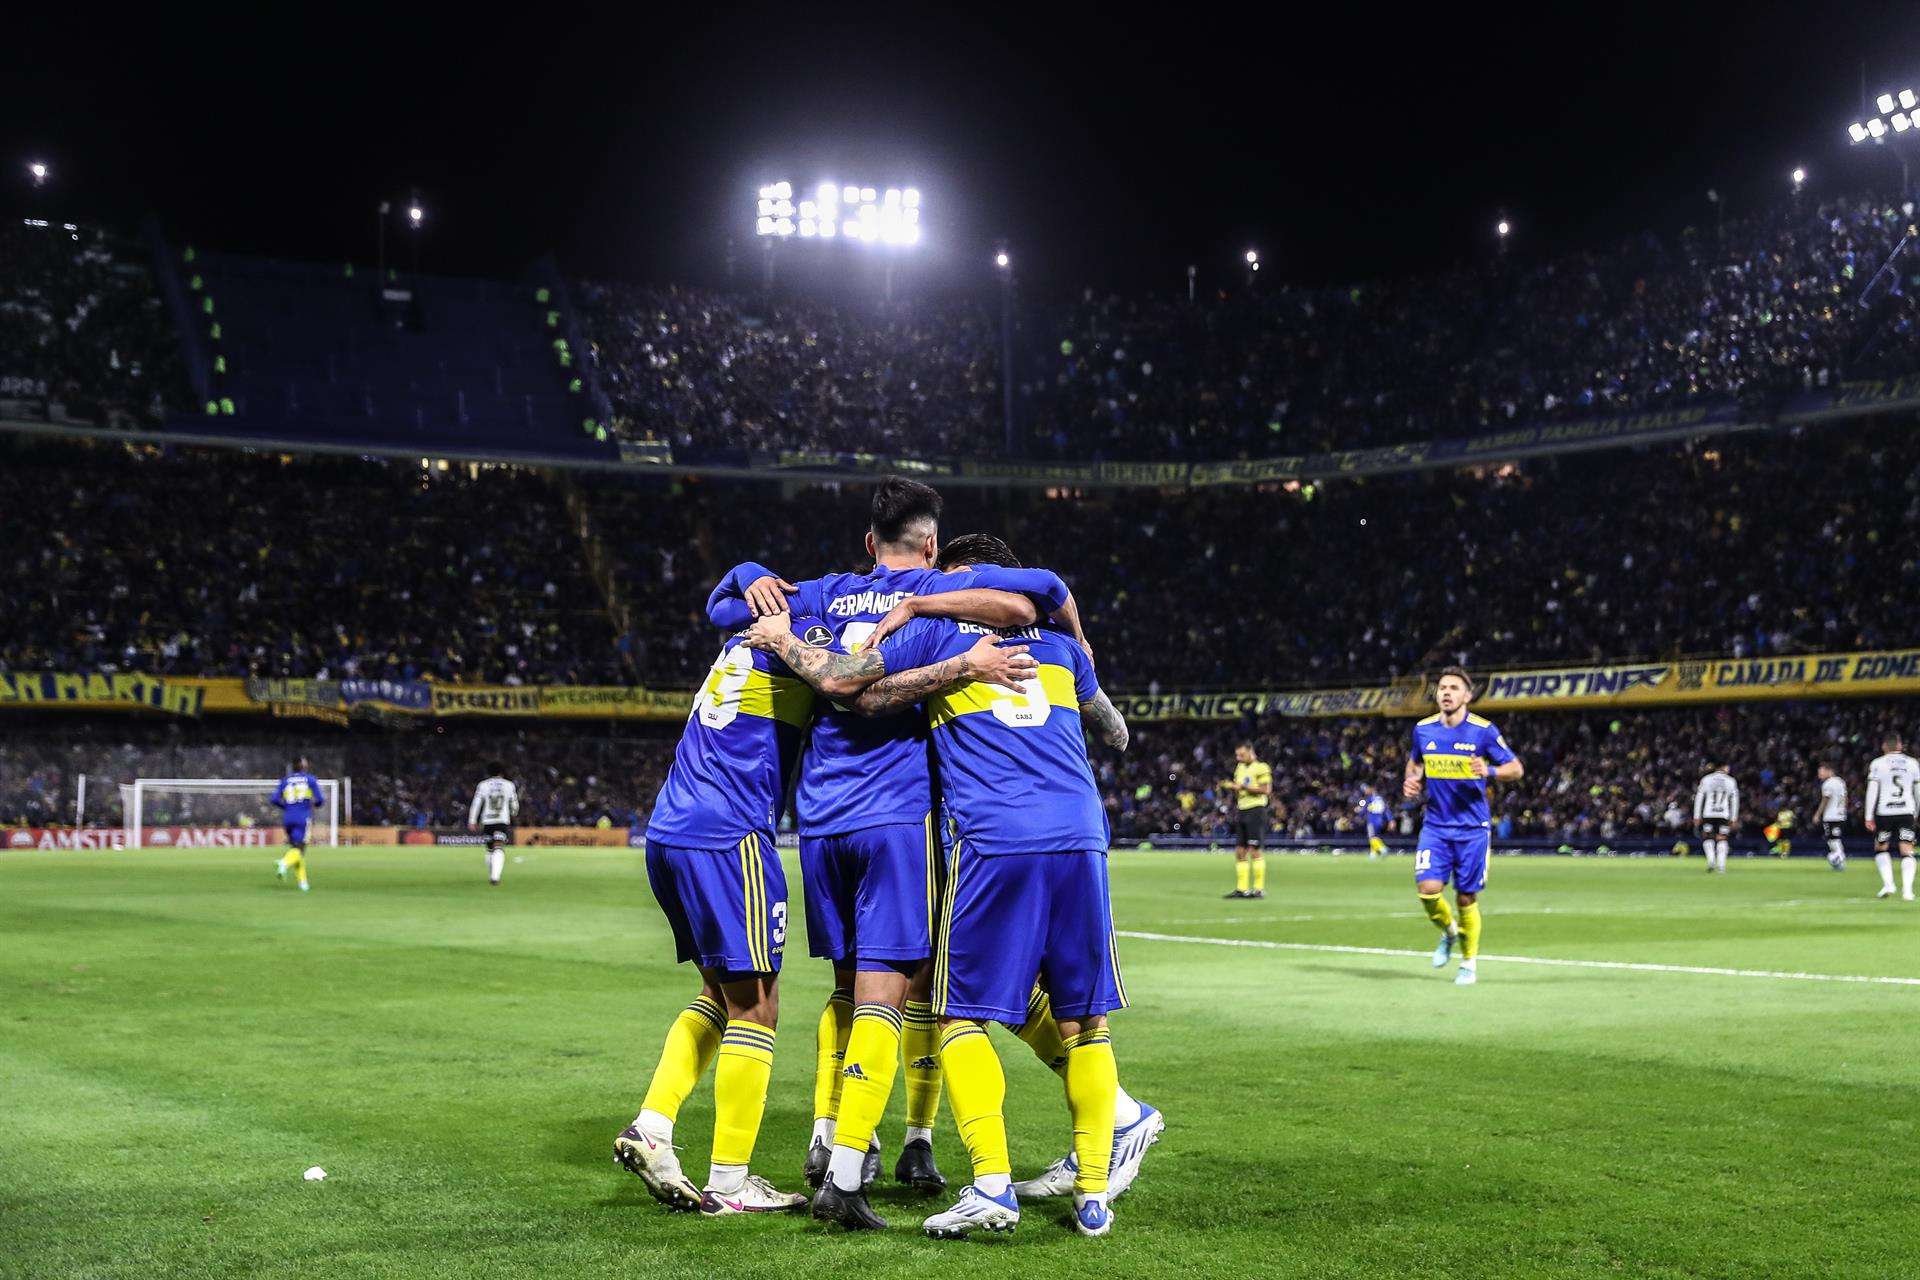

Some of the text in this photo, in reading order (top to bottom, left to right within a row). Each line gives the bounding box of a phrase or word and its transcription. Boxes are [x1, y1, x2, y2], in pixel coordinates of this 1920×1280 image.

[1814, 660, 1849, 683] DE
[54, 671, 200, 715] MARTIN
[1892, 775, 1905, 798] 5
[772, 902, 787, 944] 3
